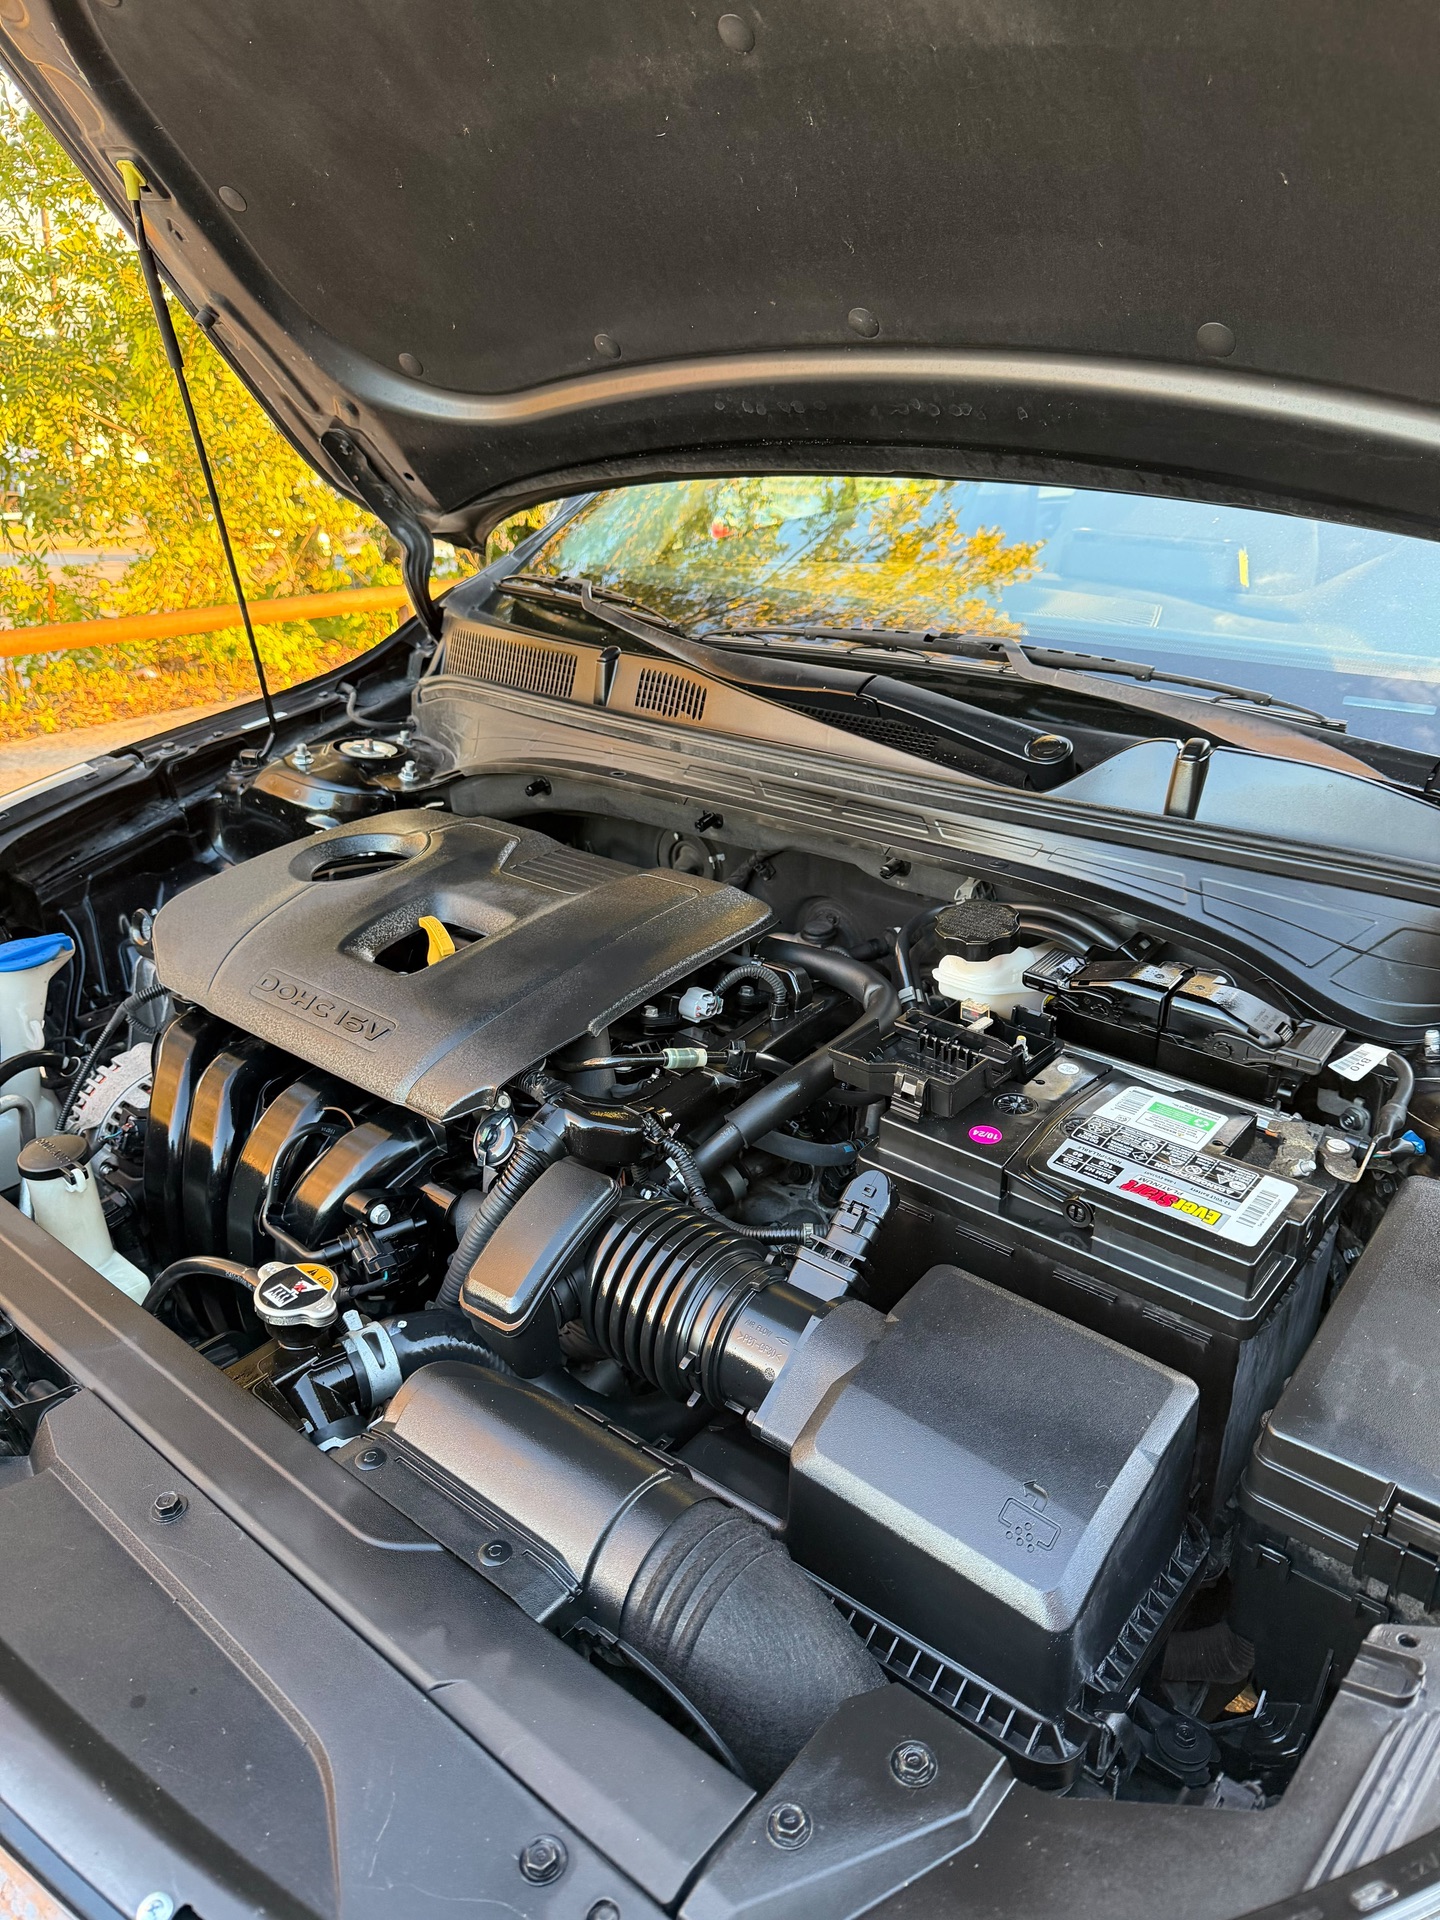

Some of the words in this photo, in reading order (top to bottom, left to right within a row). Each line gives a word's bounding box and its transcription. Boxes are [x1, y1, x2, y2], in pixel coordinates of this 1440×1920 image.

[256, 975, 335, 1018] DOHC
[334, 1010, 390, 1041] 16V
[972, 1129, 999, 1140] 10/24
[1077, 1146, 1122, 1164] NONSPILLABLE
[1095, 1169, 1114, 1179] AGM
[1098, 1161, 1114, 1169] 100
[1138, 1177, 1183, 1196] PLATINUM
[1119, 1179, 1222, 1225] EverStart
